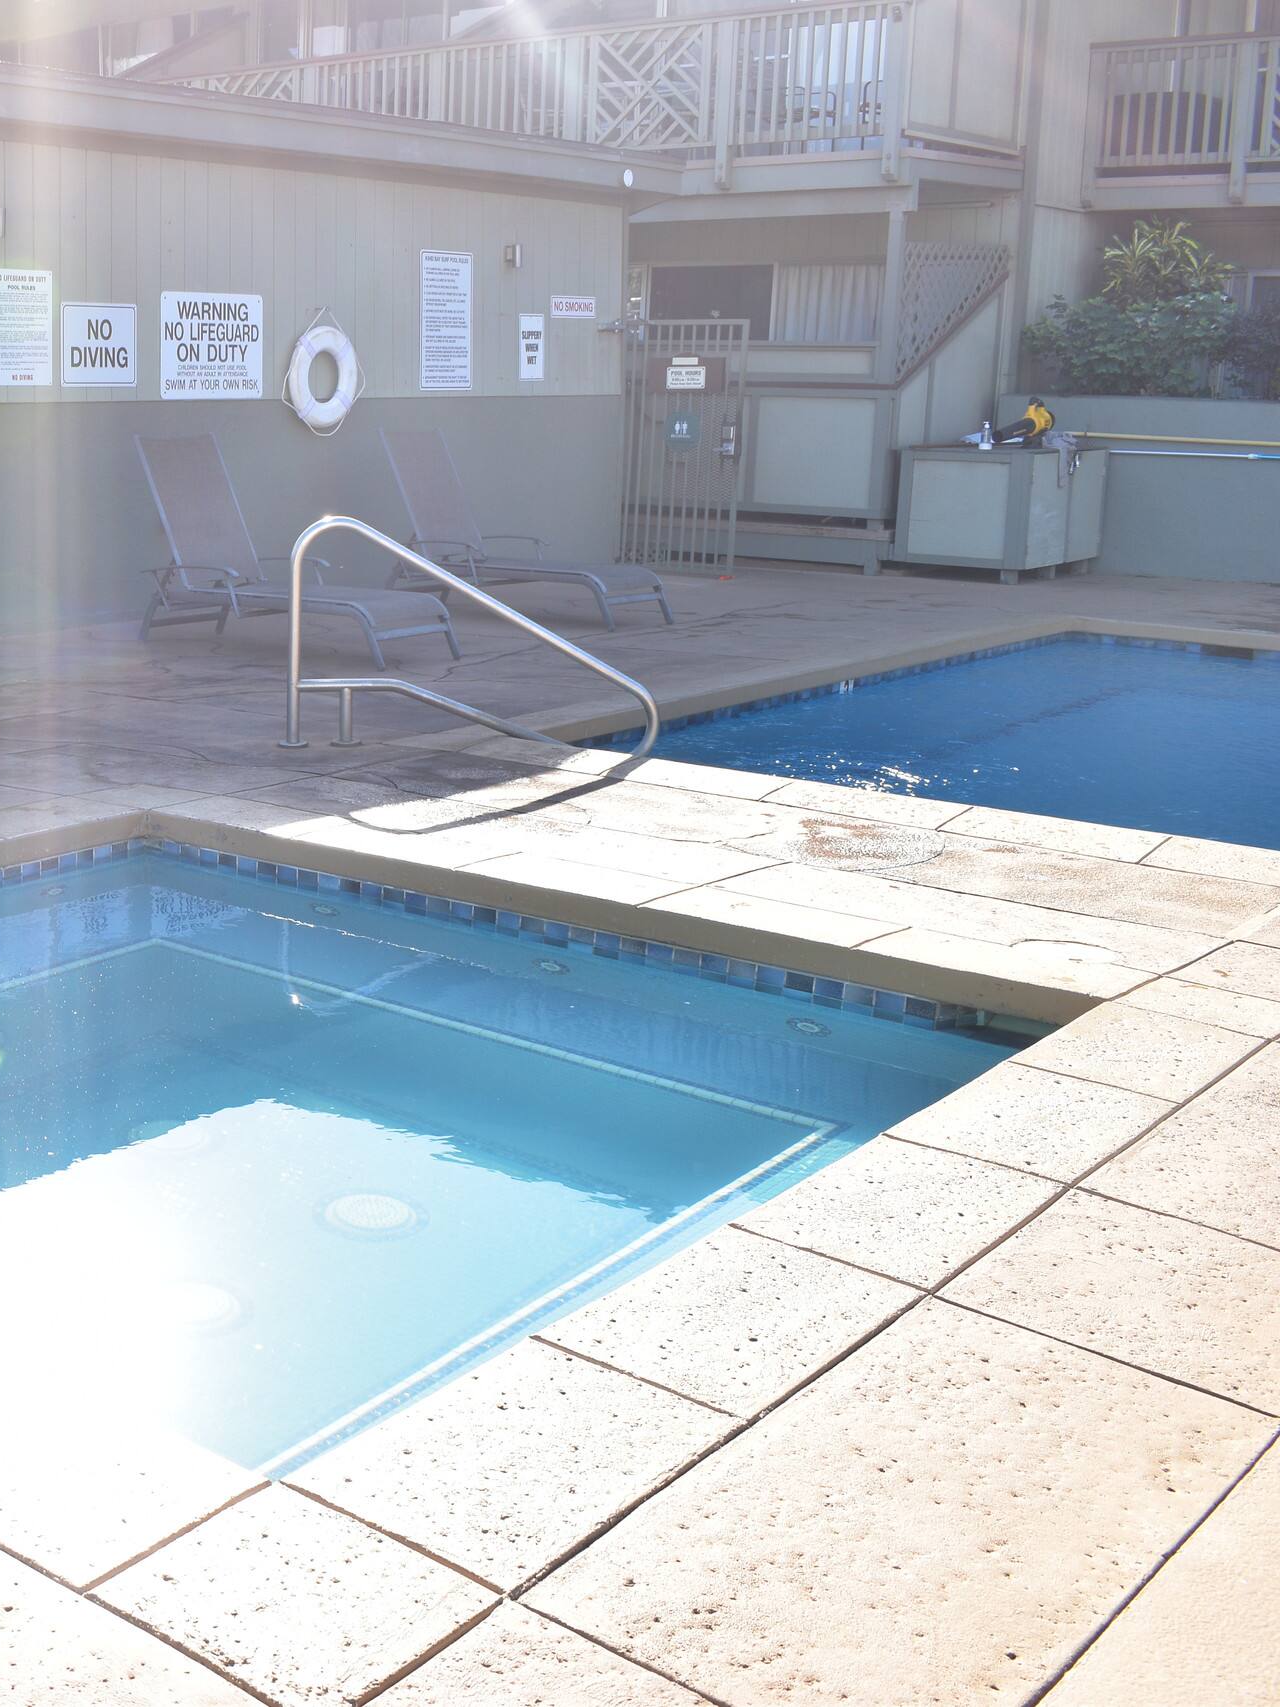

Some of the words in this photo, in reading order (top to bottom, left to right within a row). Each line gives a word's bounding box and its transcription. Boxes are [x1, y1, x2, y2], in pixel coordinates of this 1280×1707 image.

[177, 301, 249, 322] WARNING
[554, 301, 564, 312] NO
[564, 301, 594, 313] SMOKING
[87, 318, 113, 341] NO
[164, 322, 184, 341] NO
[190, 324, 259, 343] LIFEGUARD
[521, 330, 542, 340] SLIPPERY
[176, 344, 200, 362] ON
[207, 344, 248, 363] DUTY
[525, 343, 539, 352] WHEN
[70, 346, 129, 369] DIVING
[527, 355, 537, 365] WET
[165, 379, 186, 391] SWIM
[189, 379, 197, 390] AT
[200, 379, 220, 391] YOUR
[223, 379, 240, 391] OWN
[242, 379, 258, 391] RISK
